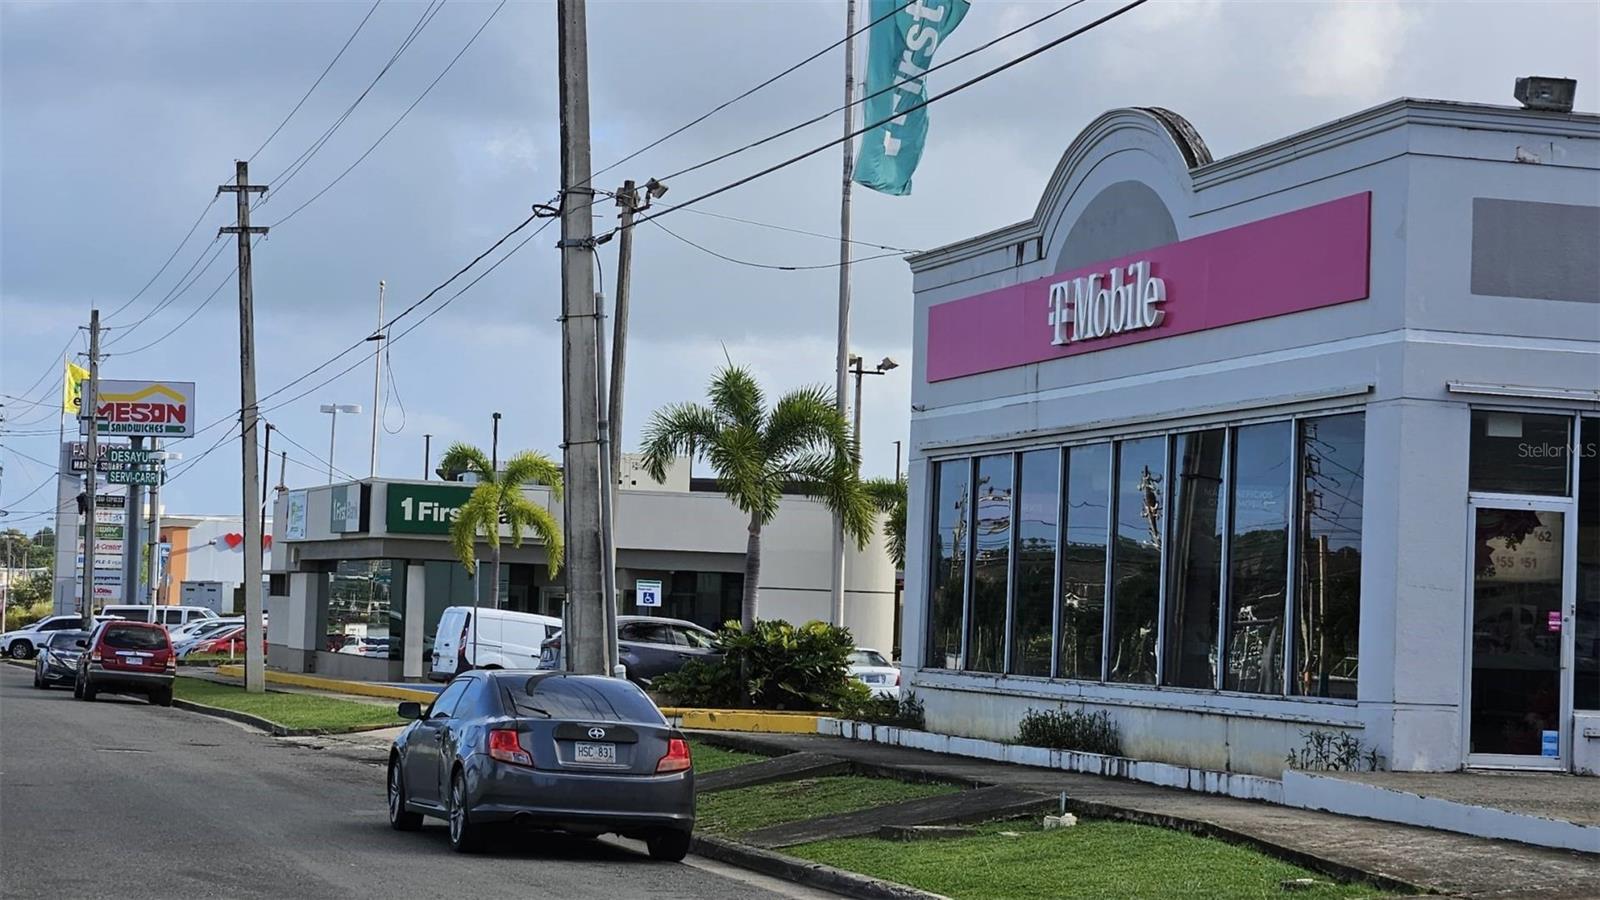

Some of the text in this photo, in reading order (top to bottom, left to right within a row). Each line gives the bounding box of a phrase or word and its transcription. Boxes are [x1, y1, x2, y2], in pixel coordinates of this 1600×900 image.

[110, 423, 164, 433] SANDWICHES
[578, 746, 613, 759] HSC 831
